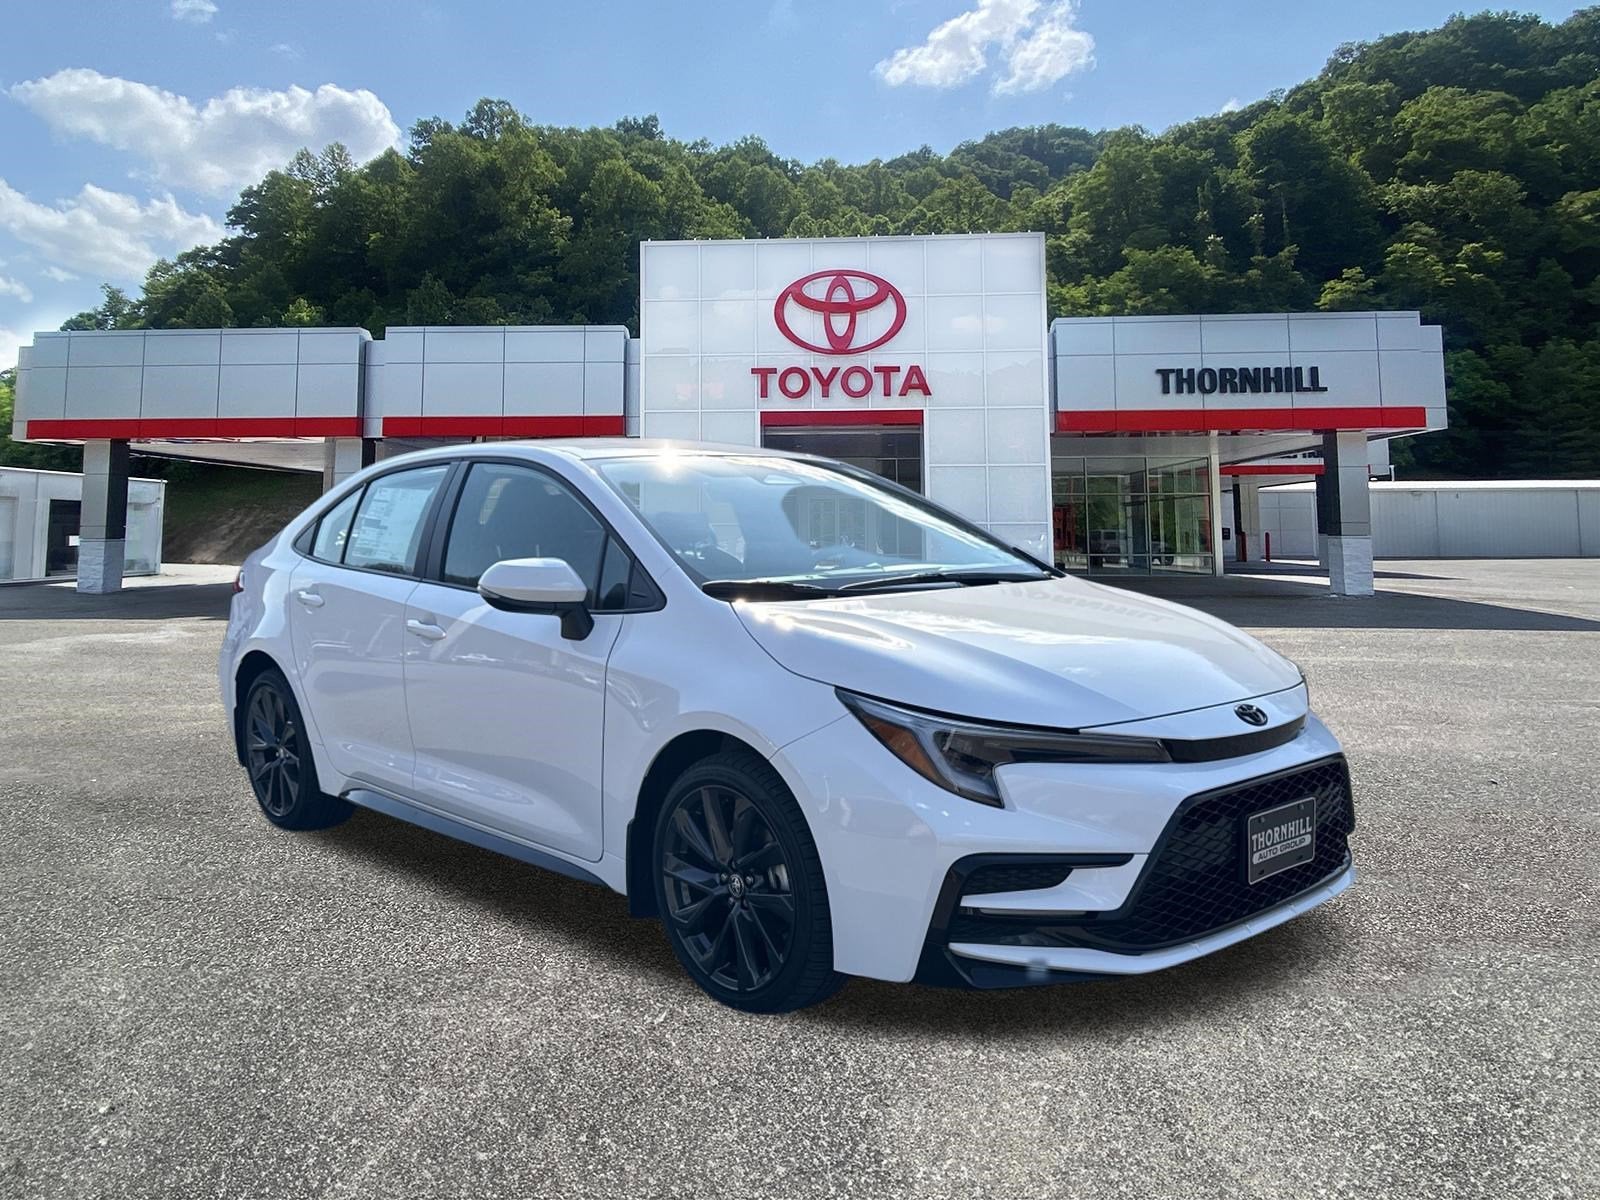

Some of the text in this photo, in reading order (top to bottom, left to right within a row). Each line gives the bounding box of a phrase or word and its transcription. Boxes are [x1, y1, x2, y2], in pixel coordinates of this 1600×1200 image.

[751, 365, 932, 399] TOYOTA
[1155, 366, 1328, 394] THORNHILL
[1251, 816, 1312, 851] THORNHILL
[1257, 837, 1306, 862] AUTO GROUP
